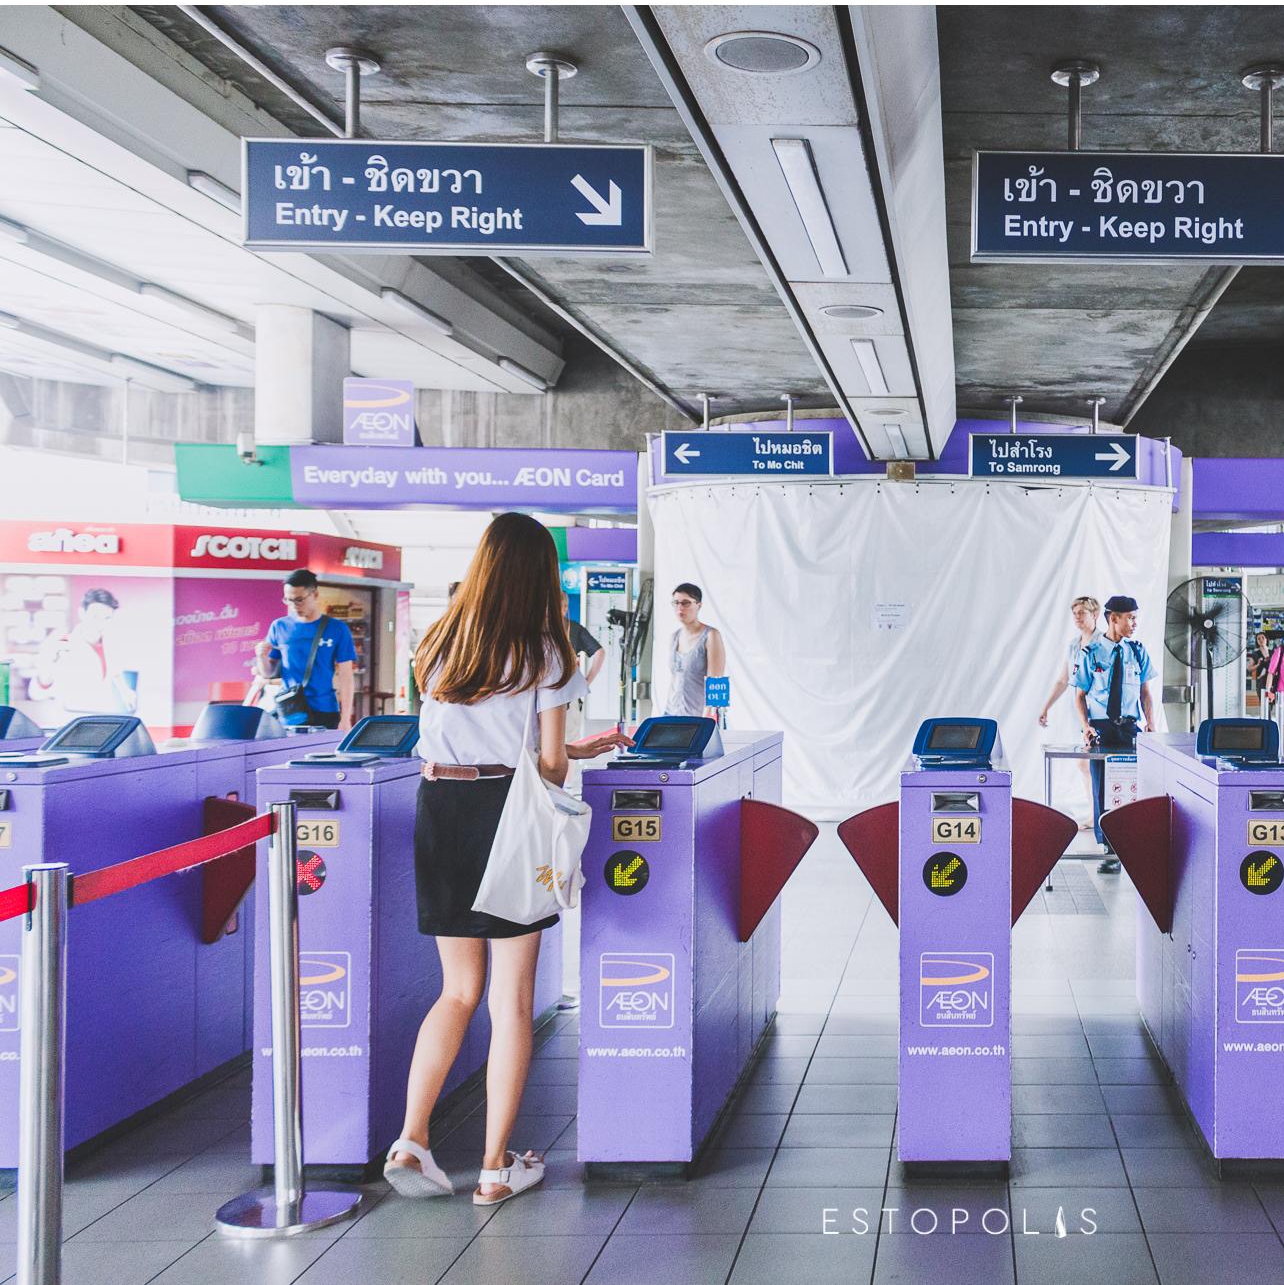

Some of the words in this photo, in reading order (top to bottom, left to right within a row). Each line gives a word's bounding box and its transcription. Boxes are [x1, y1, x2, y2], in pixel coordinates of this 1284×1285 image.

[274, 153, 331, 191] เข้า
[365, 154, 483, 194] ชิดขวา
[1003, 165, 1057, 203] เข้า
[1091, 167, 1205, 204] ชิดขวา
[275, 202, 348, 232] Entry
[374, 204, 443, 233] Keep
[451, 205, 523, 234] Right
[1004, 215, 1074, 243] Entry
[1099, 216, 1166, 244] Keep
[1174, 217, 1244, 245] Right
[752, 437, 823, 456] ไปหมอชิต
[989, 438, 1053, 460] ไปสำโรง
[752, 461, 766, 470] To
[767, 461, 783, 470] Mo
[784, 461, 805, 470] Chit
[988, 462, 1005, 473] To
[1006, 462, 1061, 476] Samrong
[304, 465, 399, 489] Everyday
[405, 466, 448, 486] with
[454, 471, 509, 490] you...
[575, 468, 624, 488] Card
[191, 534, 298, 561] SCOTCH
[708, 683, 727, 691] ออก
[617, 820, 657, 837] G15
[936, 822, 977, 839] G14
[587, 1046, 686, 1058] www.aeon.co.th
[907, 1044, 1006, 1057] www.aeon.co.th
